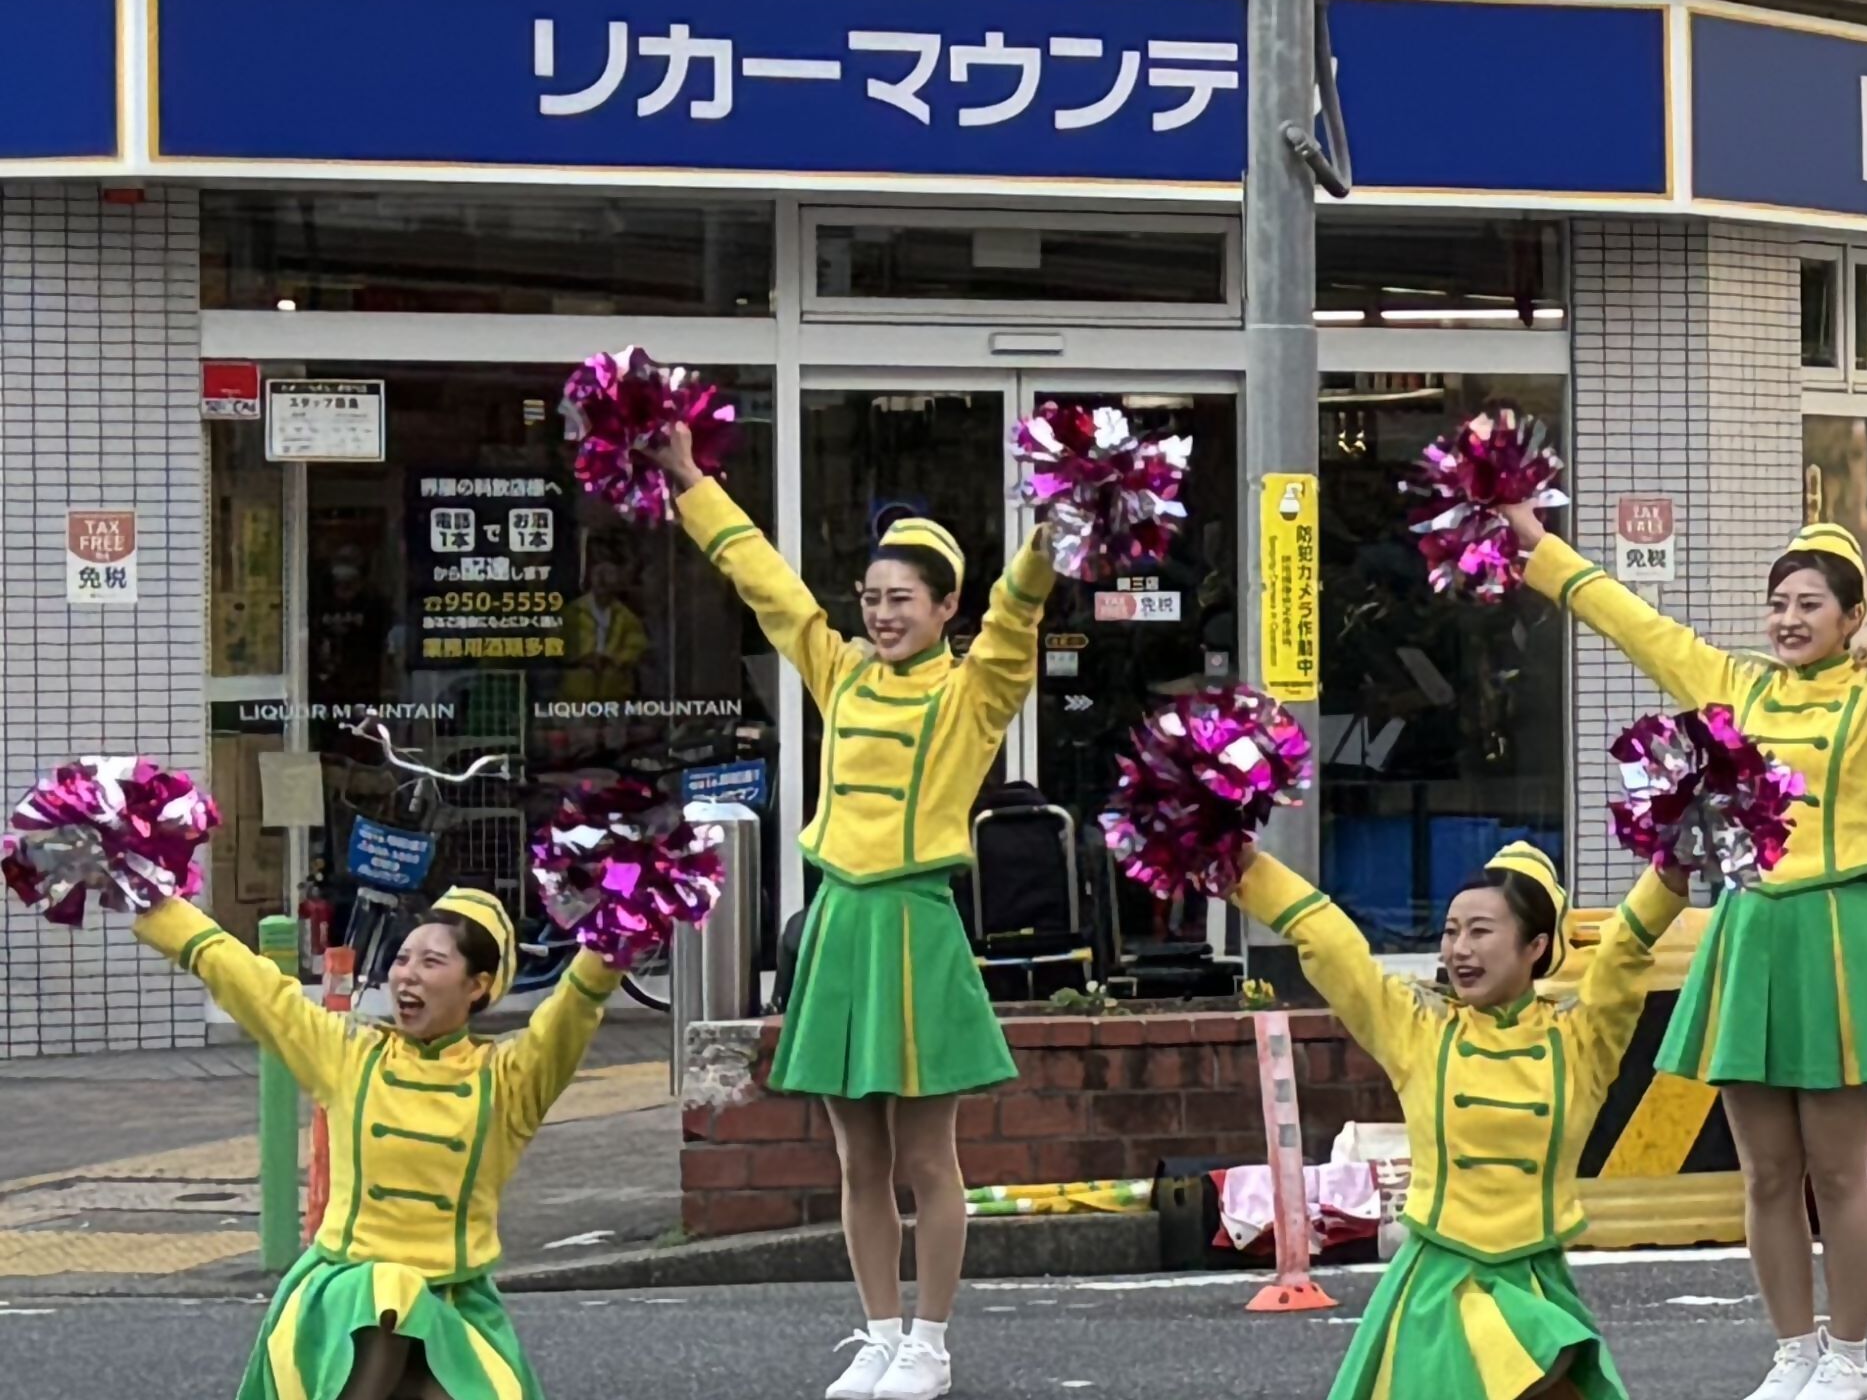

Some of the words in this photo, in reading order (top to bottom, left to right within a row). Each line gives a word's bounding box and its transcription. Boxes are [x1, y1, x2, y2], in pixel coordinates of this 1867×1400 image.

[533, 17, 1240, 132] リカーマウンテ
[84, 519, 120, 535] TAX
[79, 535, 126, 552] FREE
[444, 591, 564, 613] 950-5559
[533, 701, 620, 719] LIQUOR
[624, 698, 742, 717] MOUNTAIN
